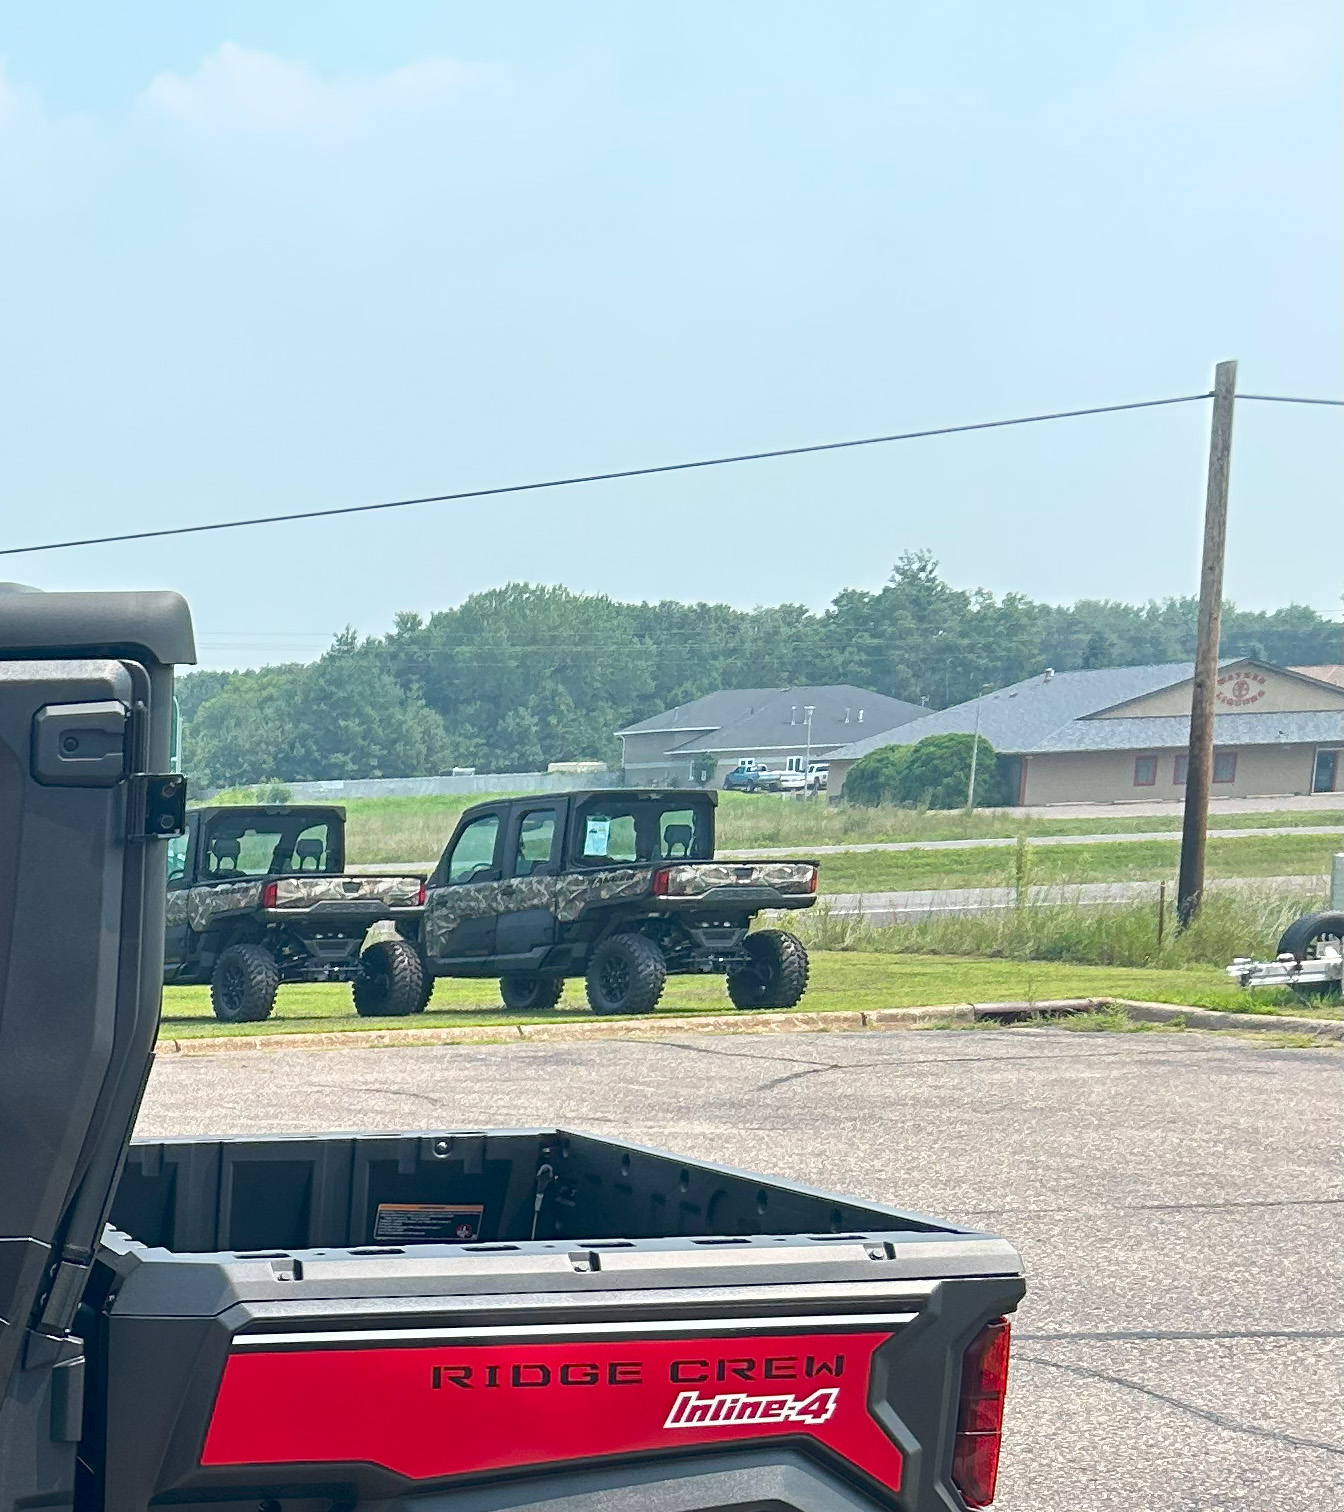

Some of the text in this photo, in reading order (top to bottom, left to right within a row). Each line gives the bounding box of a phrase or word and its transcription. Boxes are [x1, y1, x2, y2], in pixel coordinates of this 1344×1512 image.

[431, 1354, 846, 1390] RIDGE CREW
[663, 1387, 841, 1429] Inline-4
